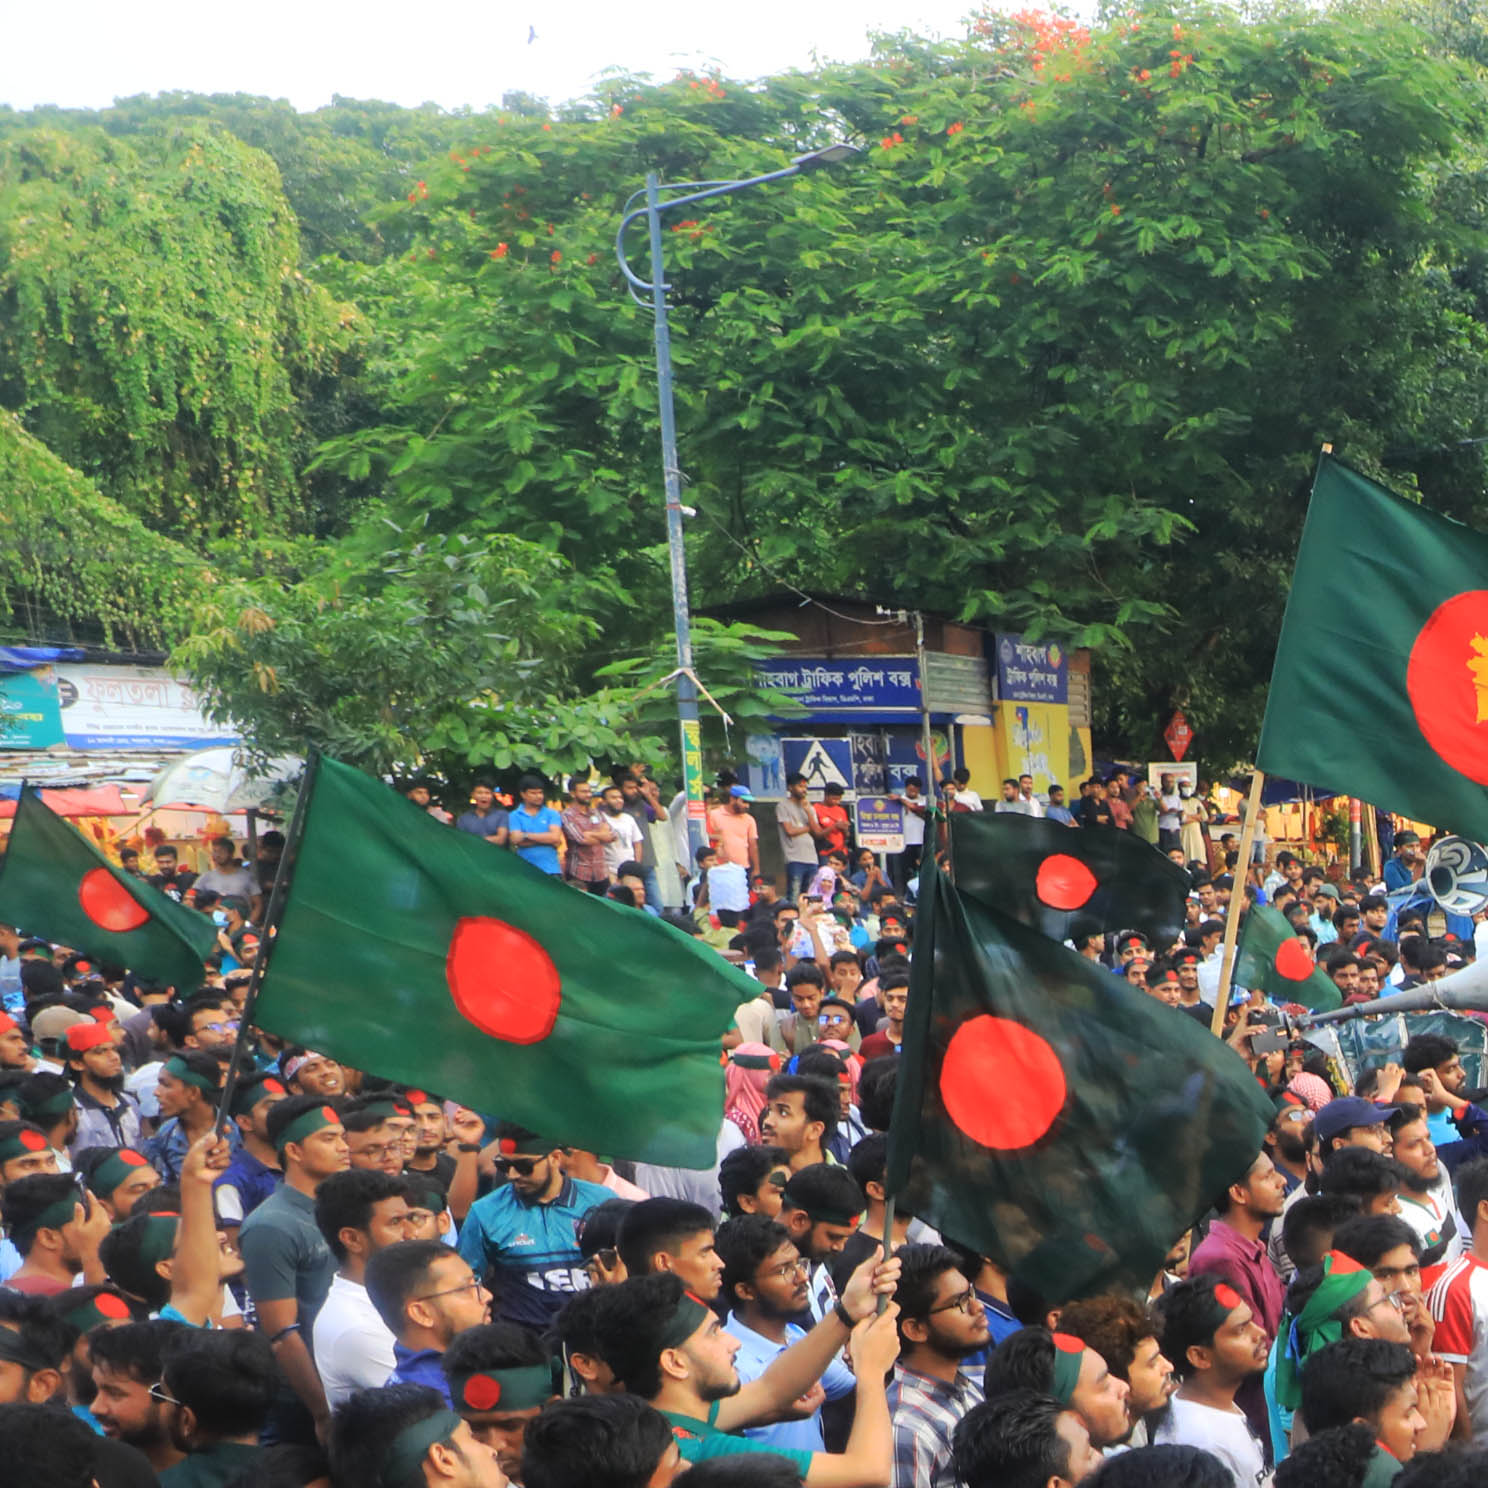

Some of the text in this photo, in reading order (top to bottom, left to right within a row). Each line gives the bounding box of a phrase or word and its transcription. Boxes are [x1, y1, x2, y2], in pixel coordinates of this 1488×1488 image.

[1016, 643, 1046, 664] শাহবাগ
[801, 666, 843, 689] ট্রাফিক
[848, 667, 883, 692] পুলিশ
[889, 670, 912, 688] বক্স
